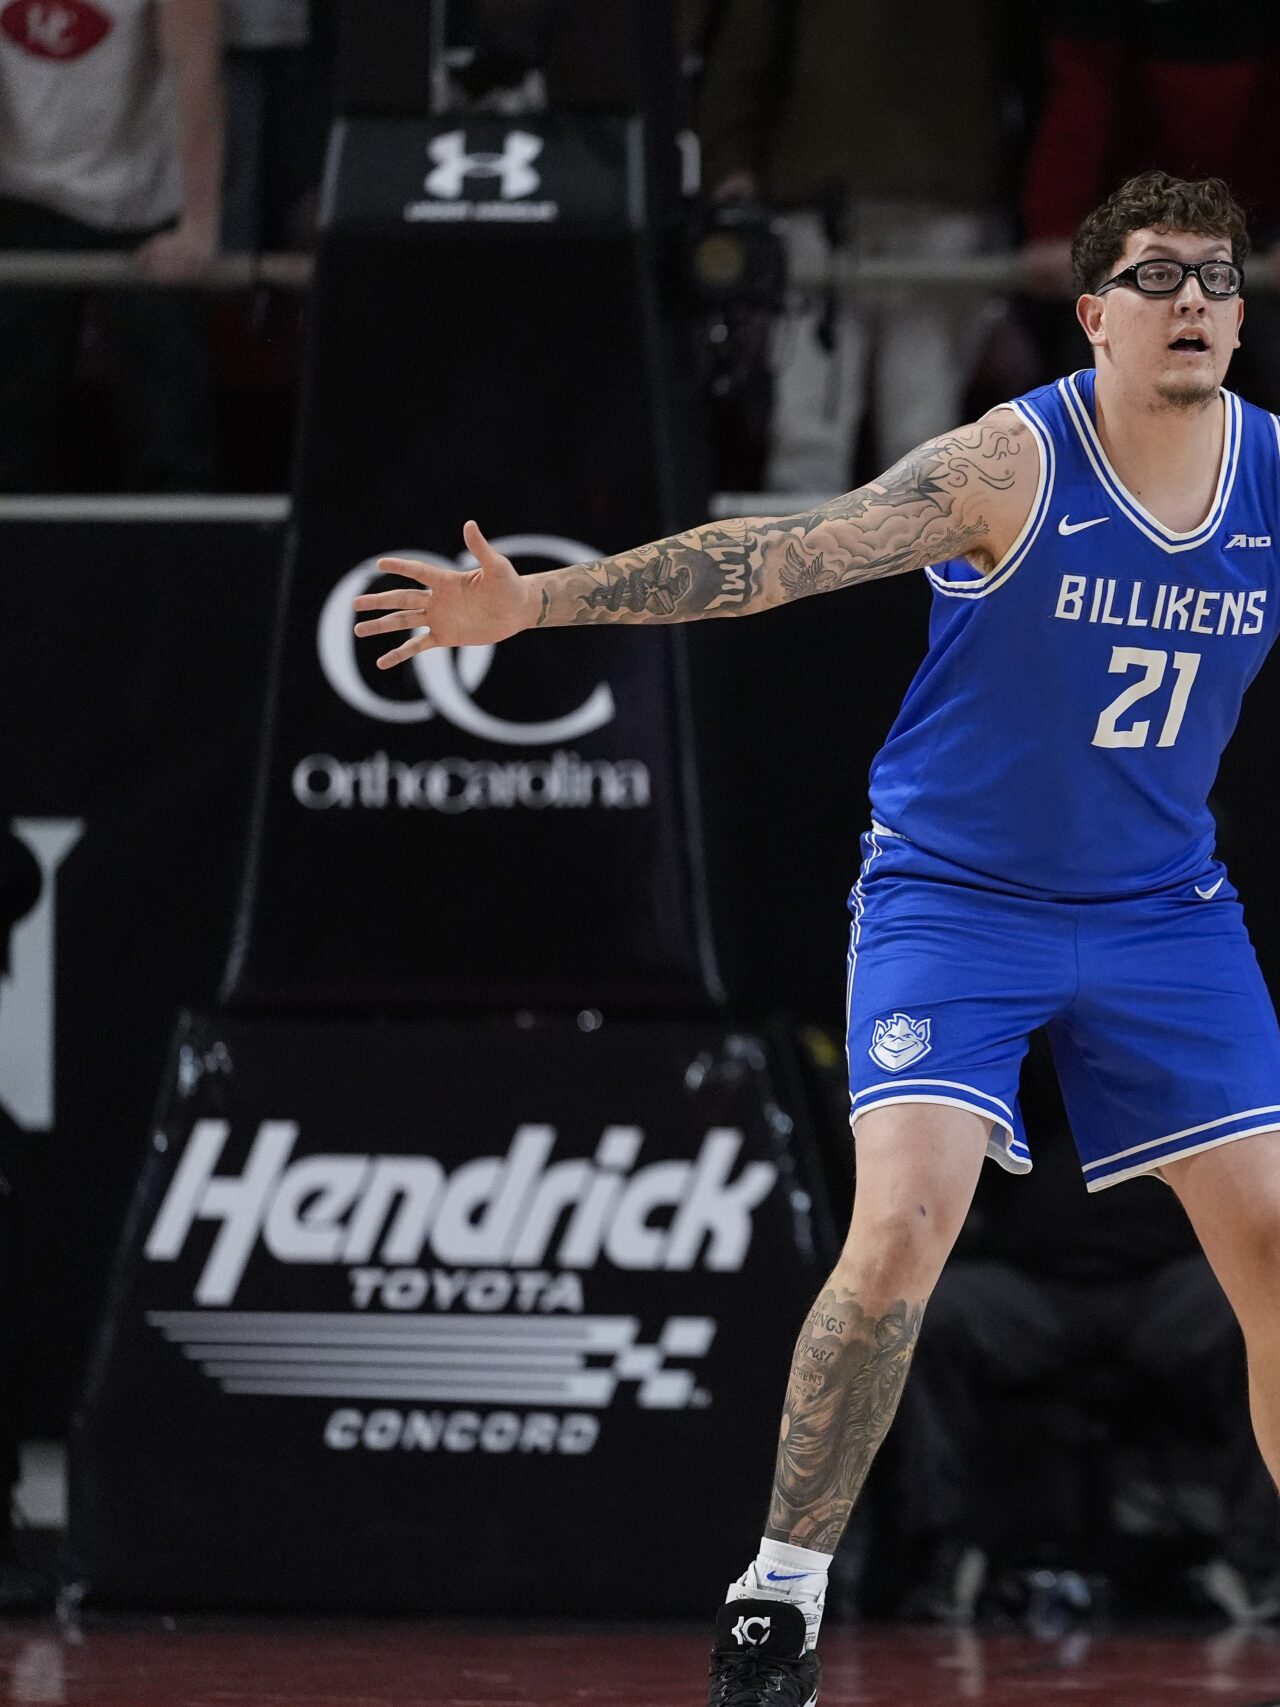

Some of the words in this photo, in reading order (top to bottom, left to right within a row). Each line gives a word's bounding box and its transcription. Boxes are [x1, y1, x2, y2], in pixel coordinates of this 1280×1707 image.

[1224, 533, 1272, 549] A10
[1054, 574, 1268, 636] BILLIKENS
[1090, 645, 1202, 749] 21
[291, 750, 651, 813] OrthoCarolina
[144, 1118, 779, 1307] Hendrick
[348, 1267, 586, 1312] TOYOTA
[324, 1408, 601, 1455] CONCORD
